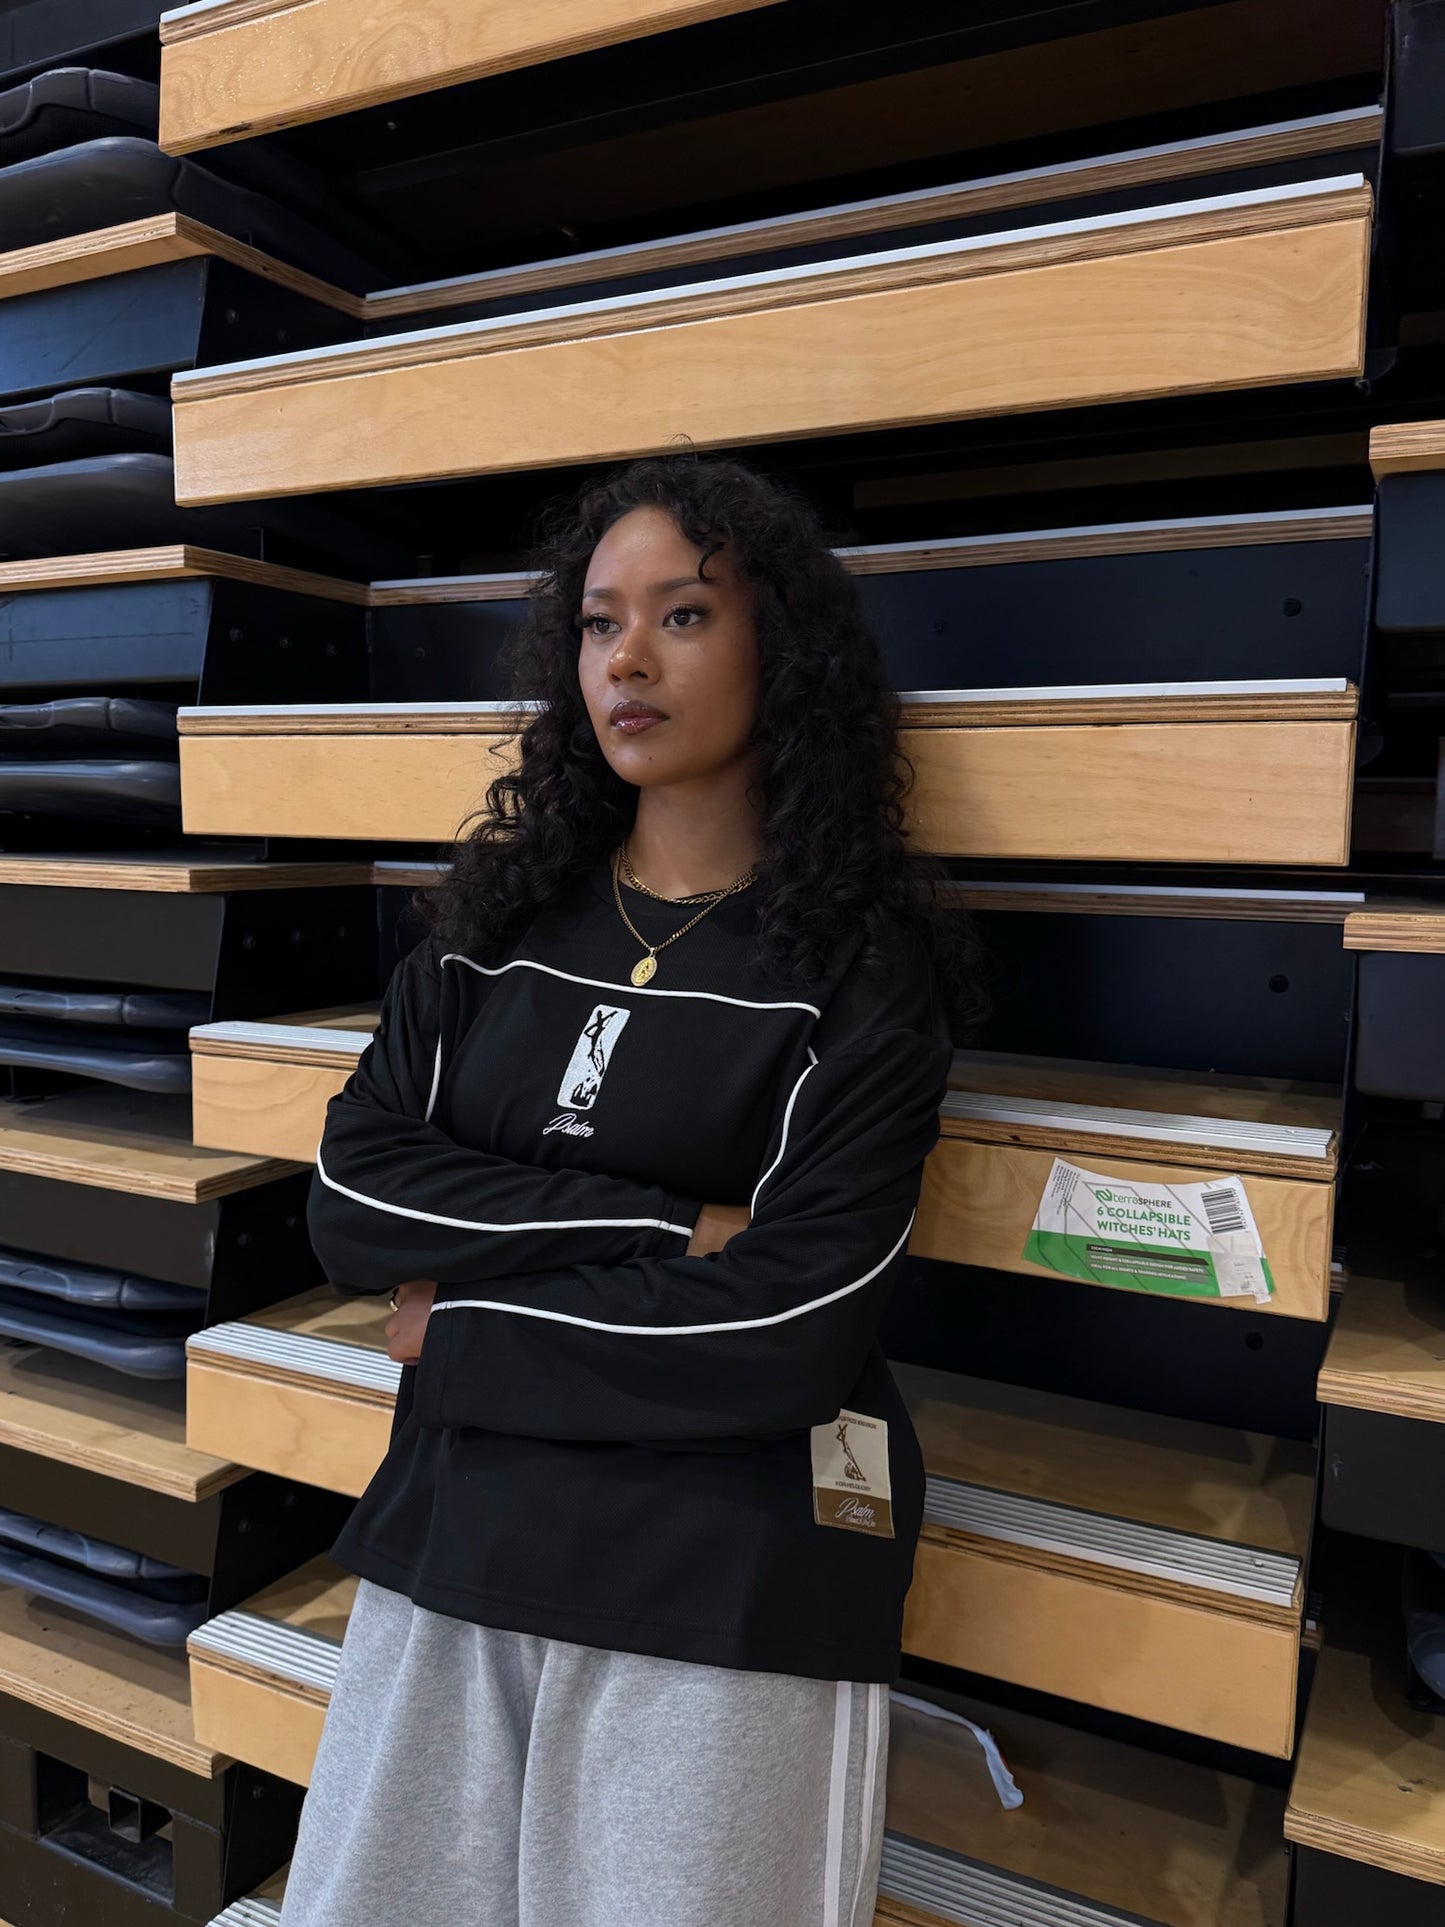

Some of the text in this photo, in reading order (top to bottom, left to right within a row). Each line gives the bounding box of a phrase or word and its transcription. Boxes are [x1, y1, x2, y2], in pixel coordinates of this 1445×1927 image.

[542, 1112, 595, 1138] Psalm
[1113, 1193, 1173, 1209] terraSPHERE
[1096, 1206, 1191, 1226] 6 COLLAPSIBLE
[1097, 1220, 1191, 1241] WITCHES' HATS
[835, 1497, 875, 1519] Psalm
